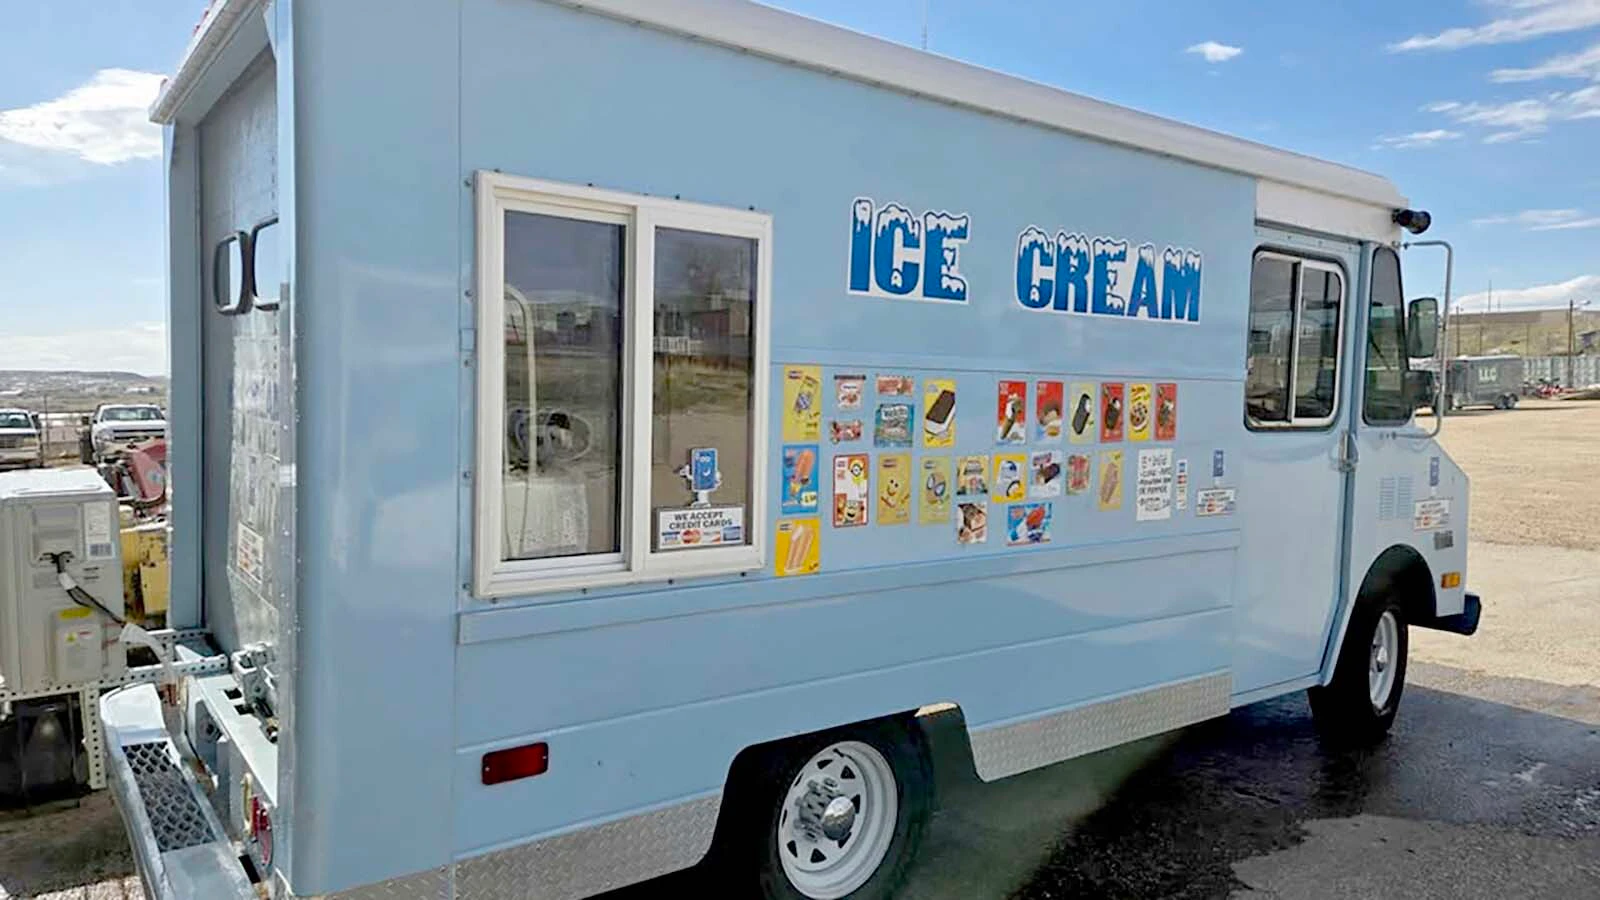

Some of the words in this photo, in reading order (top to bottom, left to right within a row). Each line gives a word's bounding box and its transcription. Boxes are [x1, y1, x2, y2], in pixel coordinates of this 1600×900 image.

[849, 198, 970, 301] ICE
[1016, 226, 1202, 323] CREAM
[1478, 367, 1498, 382] LLC
[674, 513, 688, 521] WE
[691, 511, 723, 520] ACCEPT
[668, 520, 701, 530] CREDIT
[703, 518, 733, 528] CARDS
